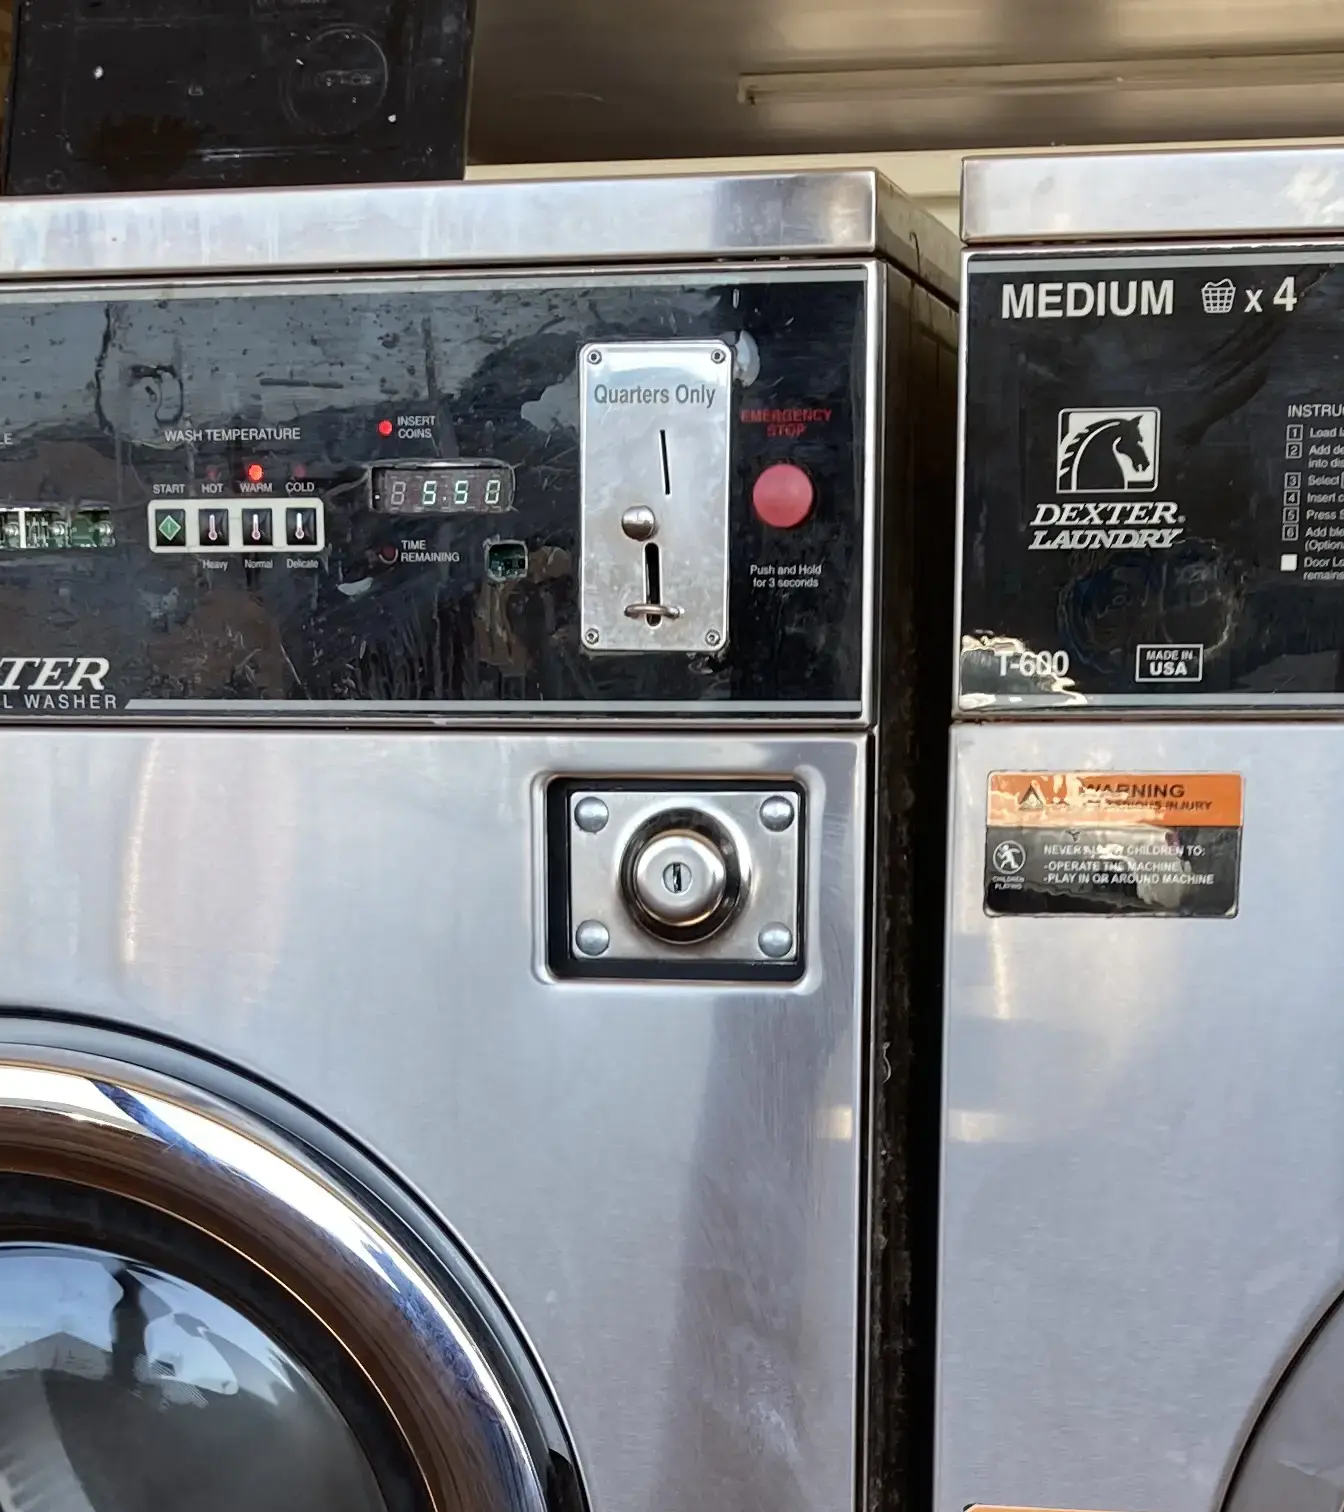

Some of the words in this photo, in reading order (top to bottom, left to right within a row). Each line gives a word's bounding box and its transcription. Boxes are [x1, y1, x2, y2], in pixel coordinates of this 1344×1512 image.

[1001, 279, 1174, 319] MEDIUM
[1273, 276, 1297, 312] 4
[594, 384, 669, 404] Quarters
[675, 384, 716, 408] Only
[398, 416, 435, 426] INSERT
[740, 408, 832, 423] EMERGENCY
[164, 429, 203, 442] WASH
[205, 428, 301, 441] TEMPERATURE
[398, 428, 432, 439] COINS
[767, 423, 806, 437] STOP
[1310, 428, 1336, 437] Load
[1309, 445, 1330, 455] Add
[152, 484, 185, 494] START
[201, 484, 224, 494] HOT
[240, 483, 273, 493] WARM
[285, 481, 315, 492] COLD
[1029, 502, 1178, 526] DEXTER
[1028, 528, 1184, 550] LAUNDRY
[401, 541, 426, 551] TIME
[401, 551, 460, 563] REMAINING
[203, 559, 228, 571] Heavy
[244, 558, 273, 569] Normal
[287, 558, 319, 568] Delicate
[750, 565, 775, 575] Push
[777, 565, 796, 575] and
[798, 564, 822, 575] Hold
[753, 577, 767, 588] for
[768, 578, 775, 587] 3
[777, 577, 819, 588] seconds
[1146, 650, 1177, 661] MADE
[1179, 650, 1194, 660] IN
[995, 650, 1069, 677] T-600
[1149, 661, 1187, 676] USA
[25, 694, 118, 709] WASHER
